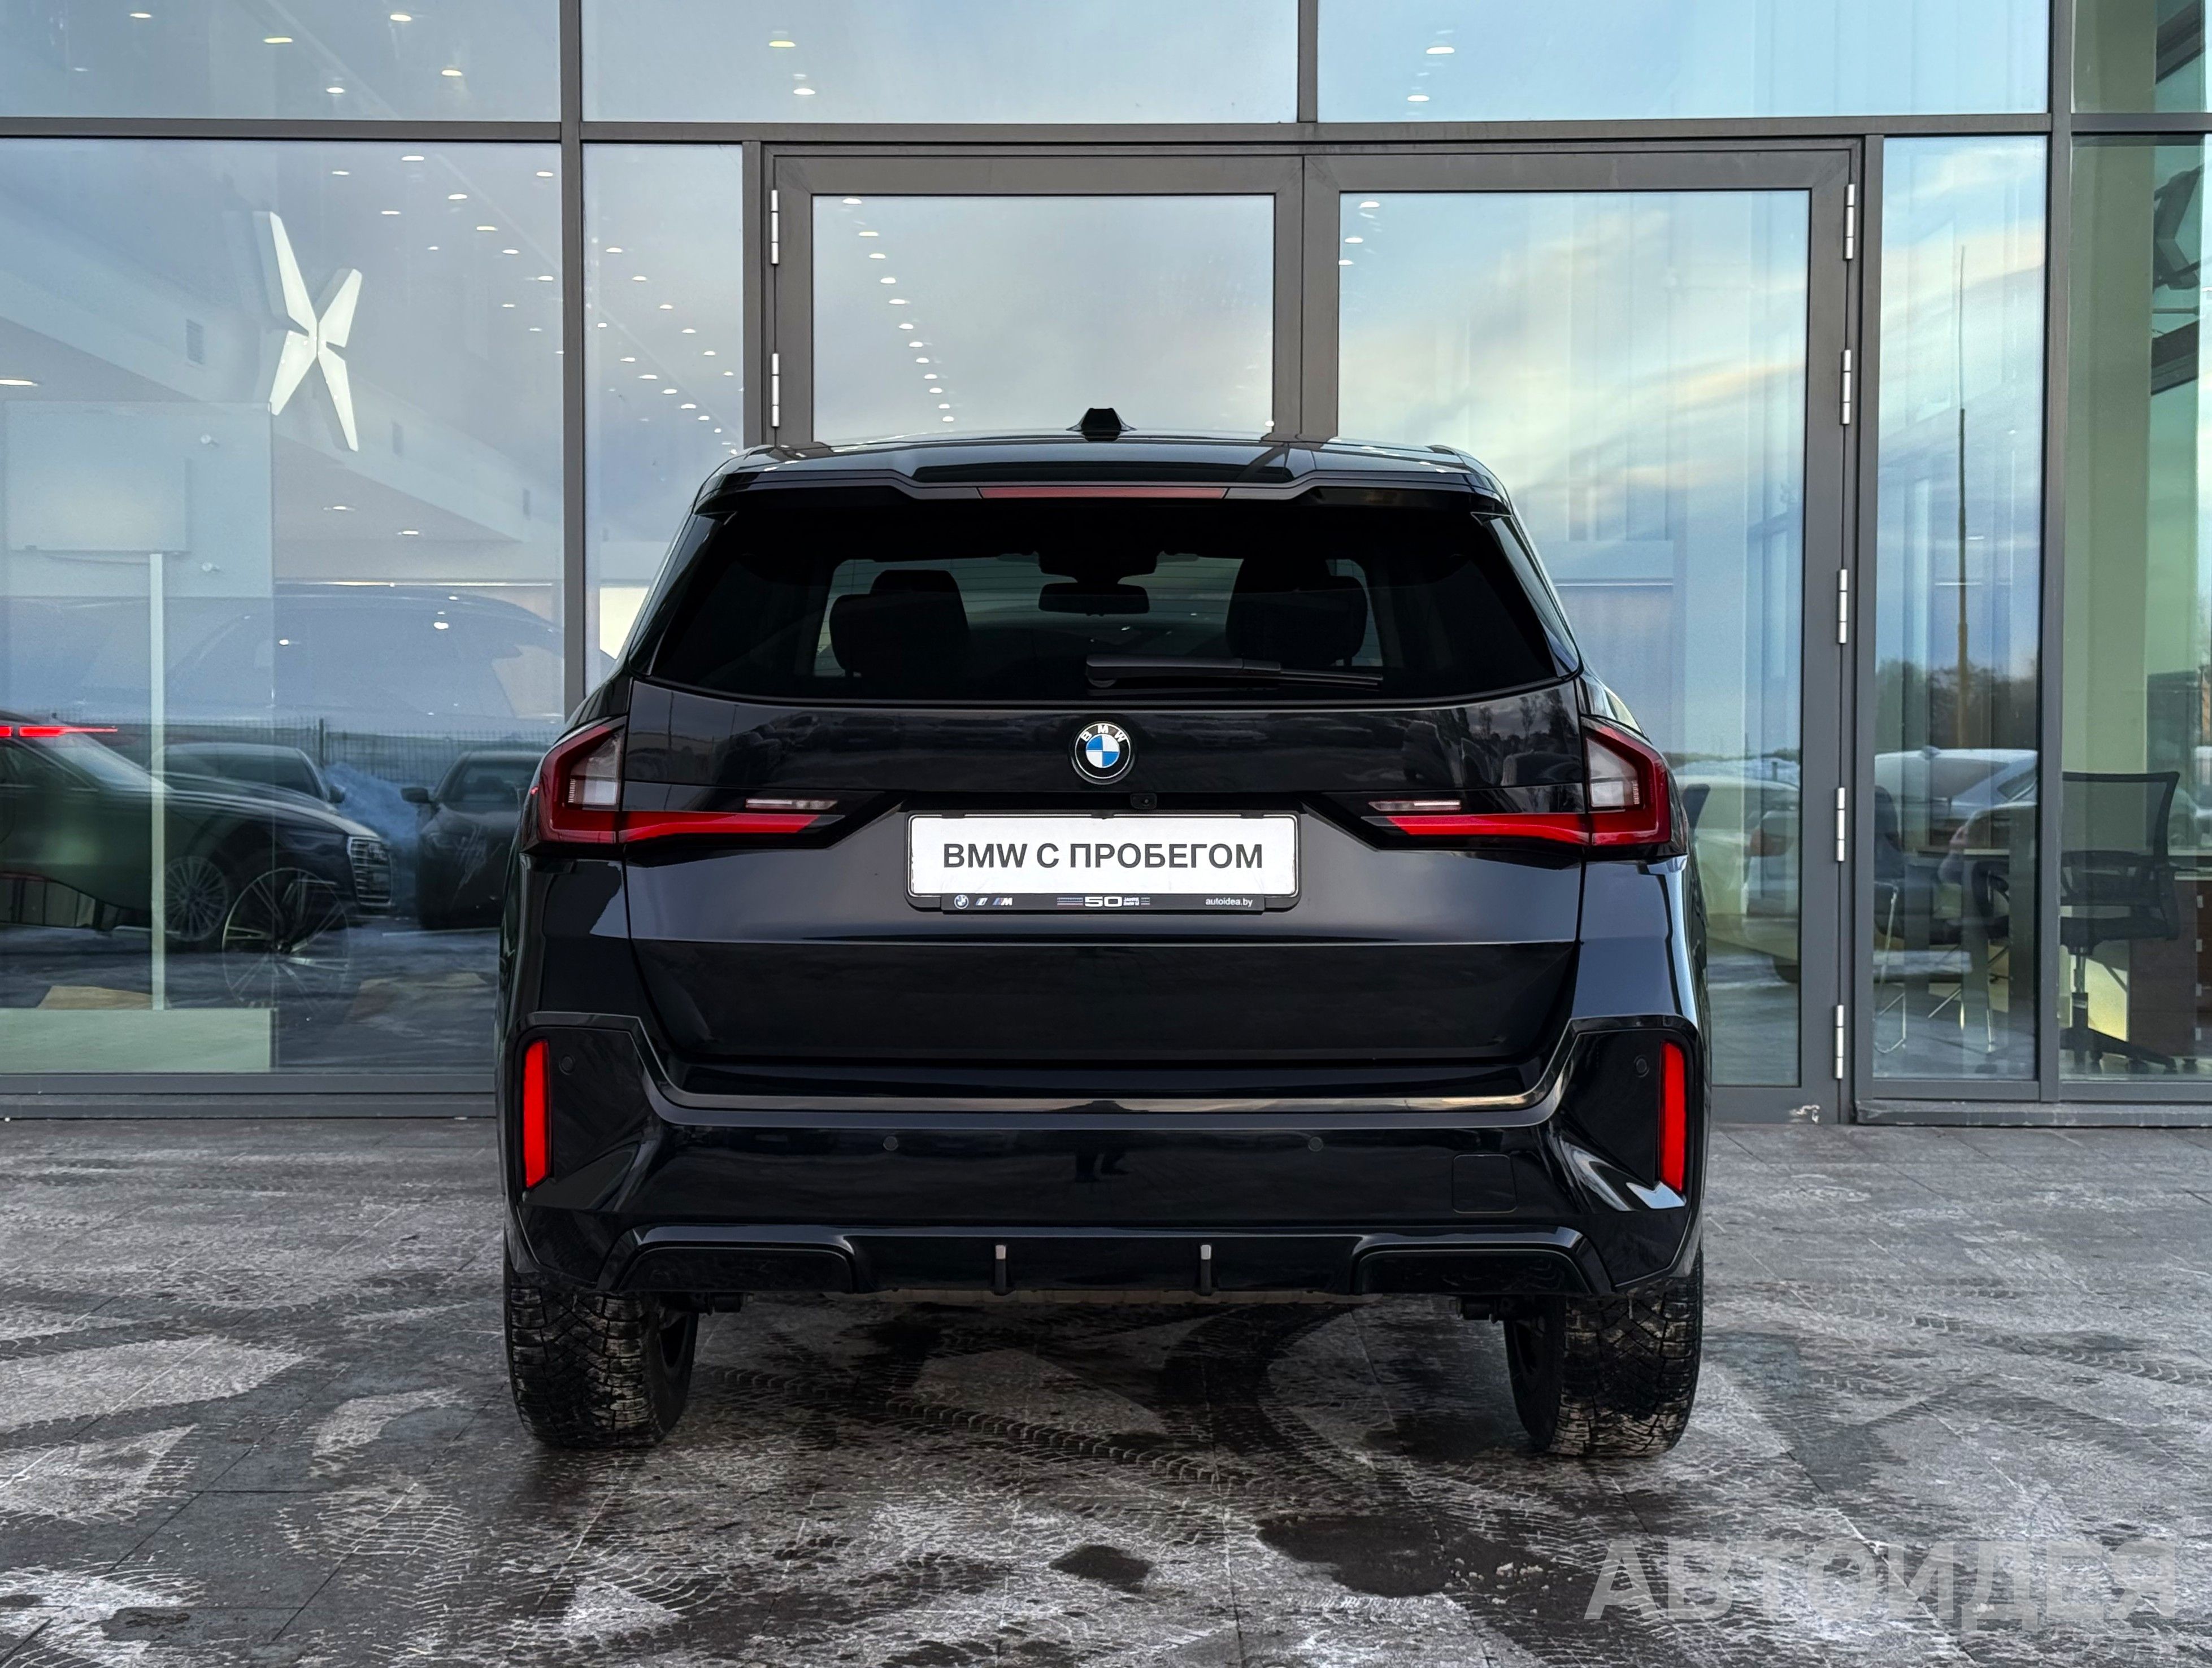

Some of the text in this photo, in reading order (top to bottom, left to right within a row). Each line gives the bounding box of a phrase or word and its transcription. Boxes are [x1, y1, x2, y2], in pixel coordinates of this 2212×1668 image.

[1080, 725, 1127, 742] BMW
[944, 843, 1263, 869] BMW С ПРОБЕГОМ
[1084, 896, 1123, 907] 50
[1205, 897, 1253, 908] autoidea.by
